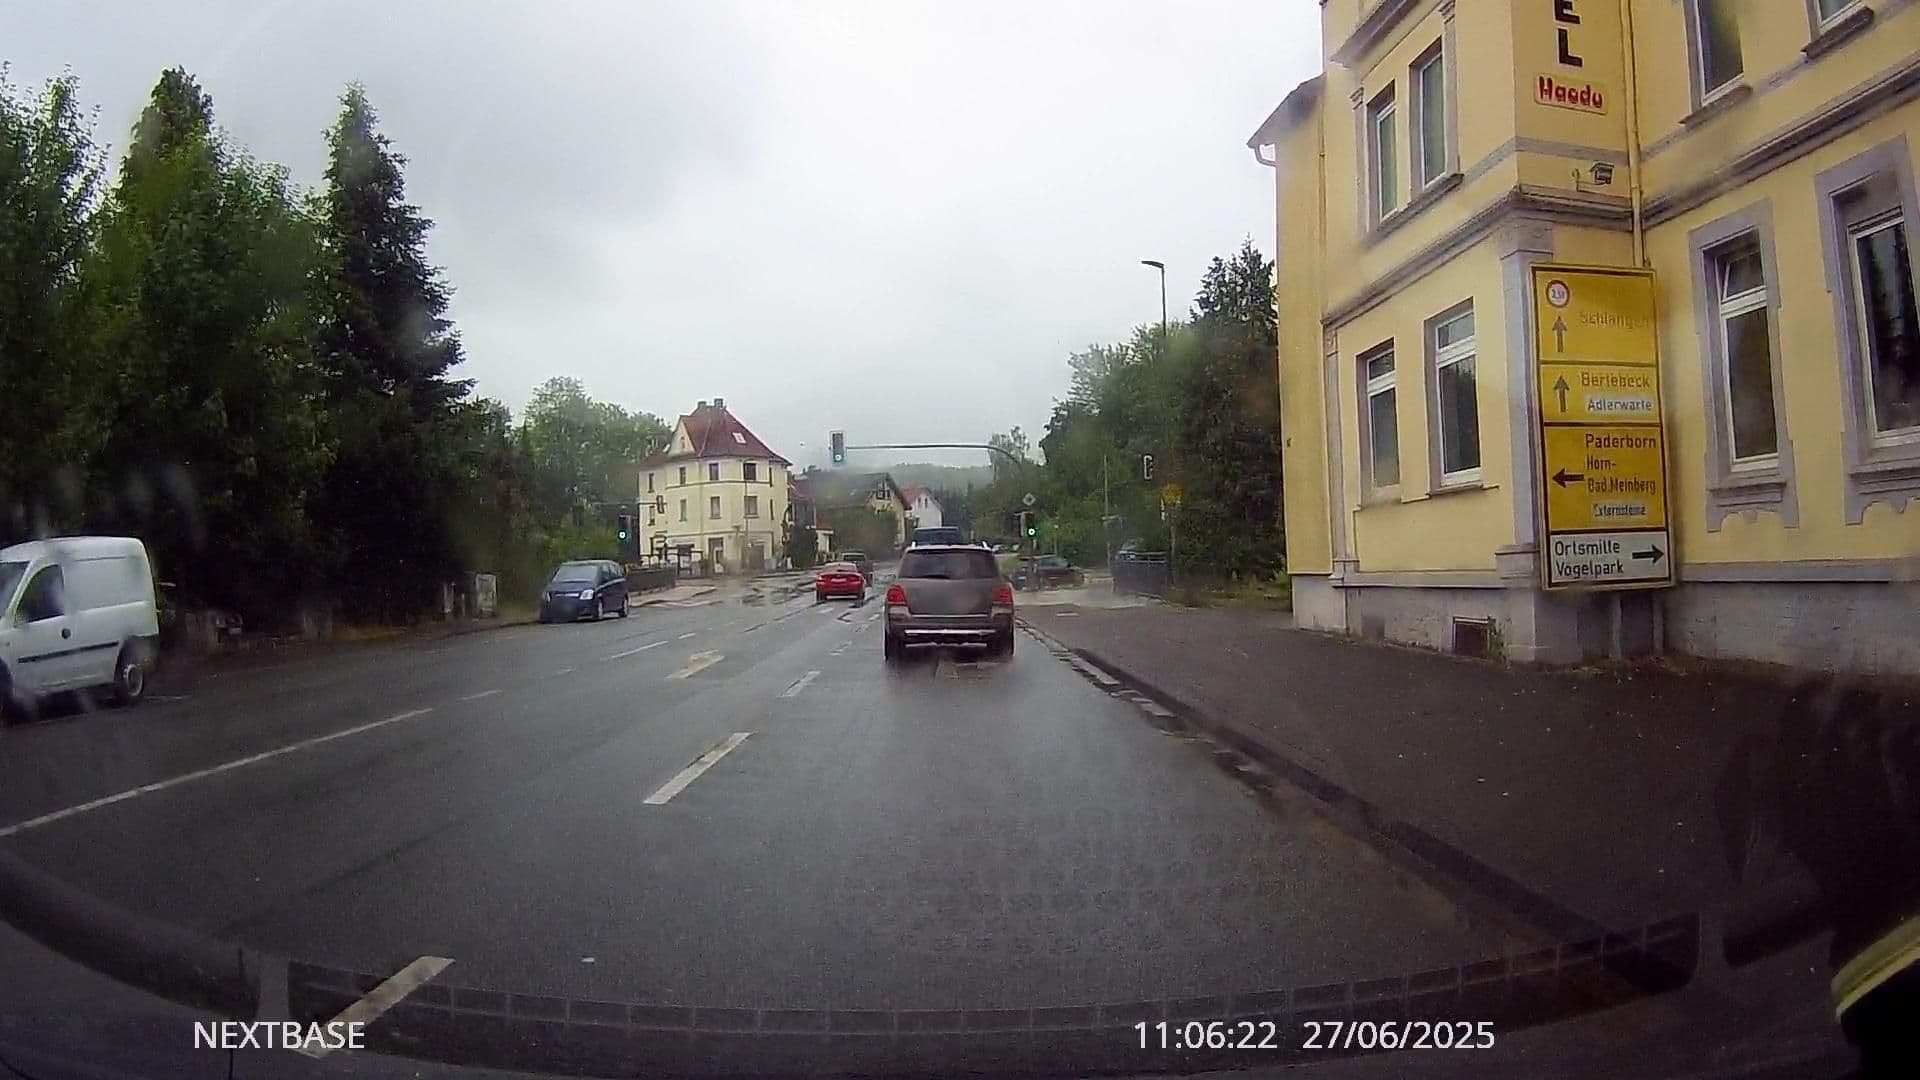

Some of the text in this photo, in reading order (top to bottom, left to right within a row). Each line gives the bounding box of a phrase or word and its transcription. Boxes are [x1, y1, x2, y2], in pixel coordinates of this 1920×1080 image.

[1588, 398, 1652, 412] Adlerwarte
[1585, 433, 1656, 449] Paderborn
[1586, 454, 1617, 471] Horn-
[1588, 476, 1656, 496] Bad Meinberg
[1555, 560, 1625, 580] Vogelpark
